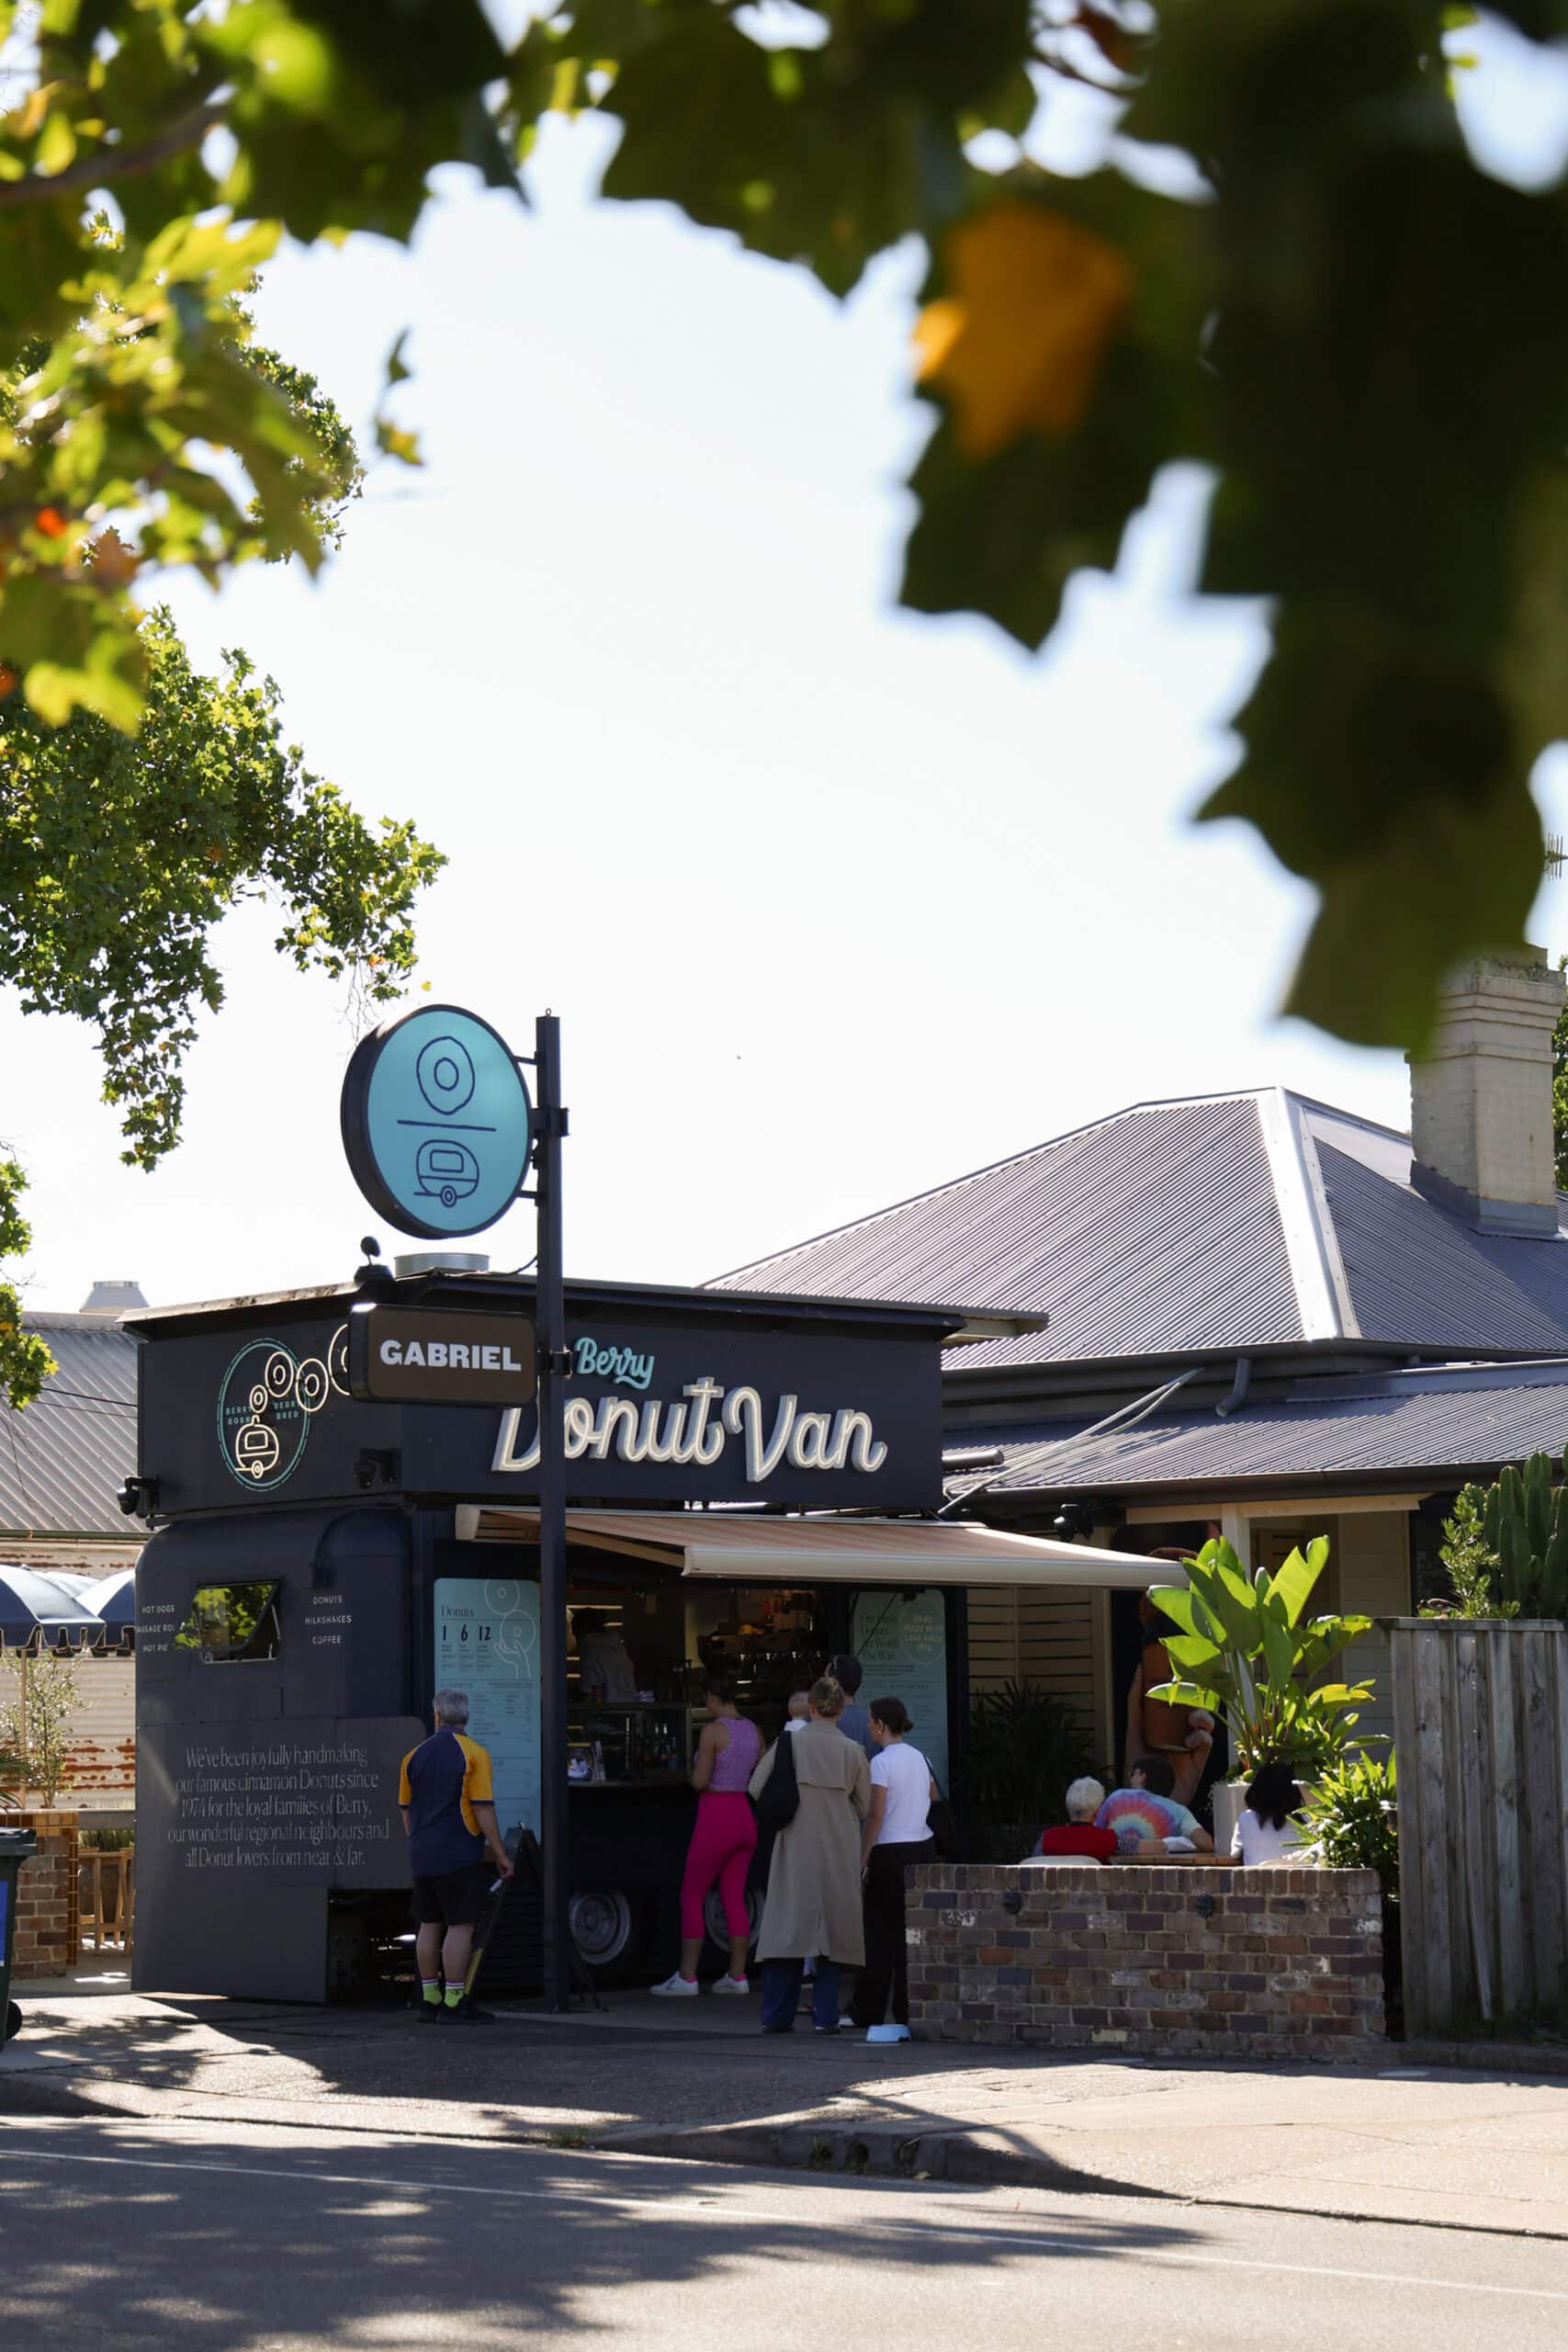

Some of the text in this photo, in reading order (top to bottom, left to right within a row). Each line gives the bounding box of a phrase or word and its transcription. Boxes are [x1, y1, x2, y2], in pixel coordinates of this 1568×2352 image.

[380, 1340, 522, 1371] GABRIEL
[574, 1338, 658, 1389] Berry
[722, 1386, 888, 1482] Van
[312, 1595, 343, 1605] DONUTS
[305, 1614, 353, 1625] MILKSHAKES
[443, 1624, 492, 1641] 1 6 12
[312, 1634, 343, 1645] COFFEE
[186, 1742, 368, 1770] We've been joyfully handmaking
[176, 1769, 379, 1793] our famous cinnamon Donuts since
[181, 1793, 373, 1821] 1974 for the loyal families of Berry,
[168, 1818, 389, 1846] our wonderful regional neighbours and
[185, 1845, 367, 1868] all Donut lovers from near & far.
